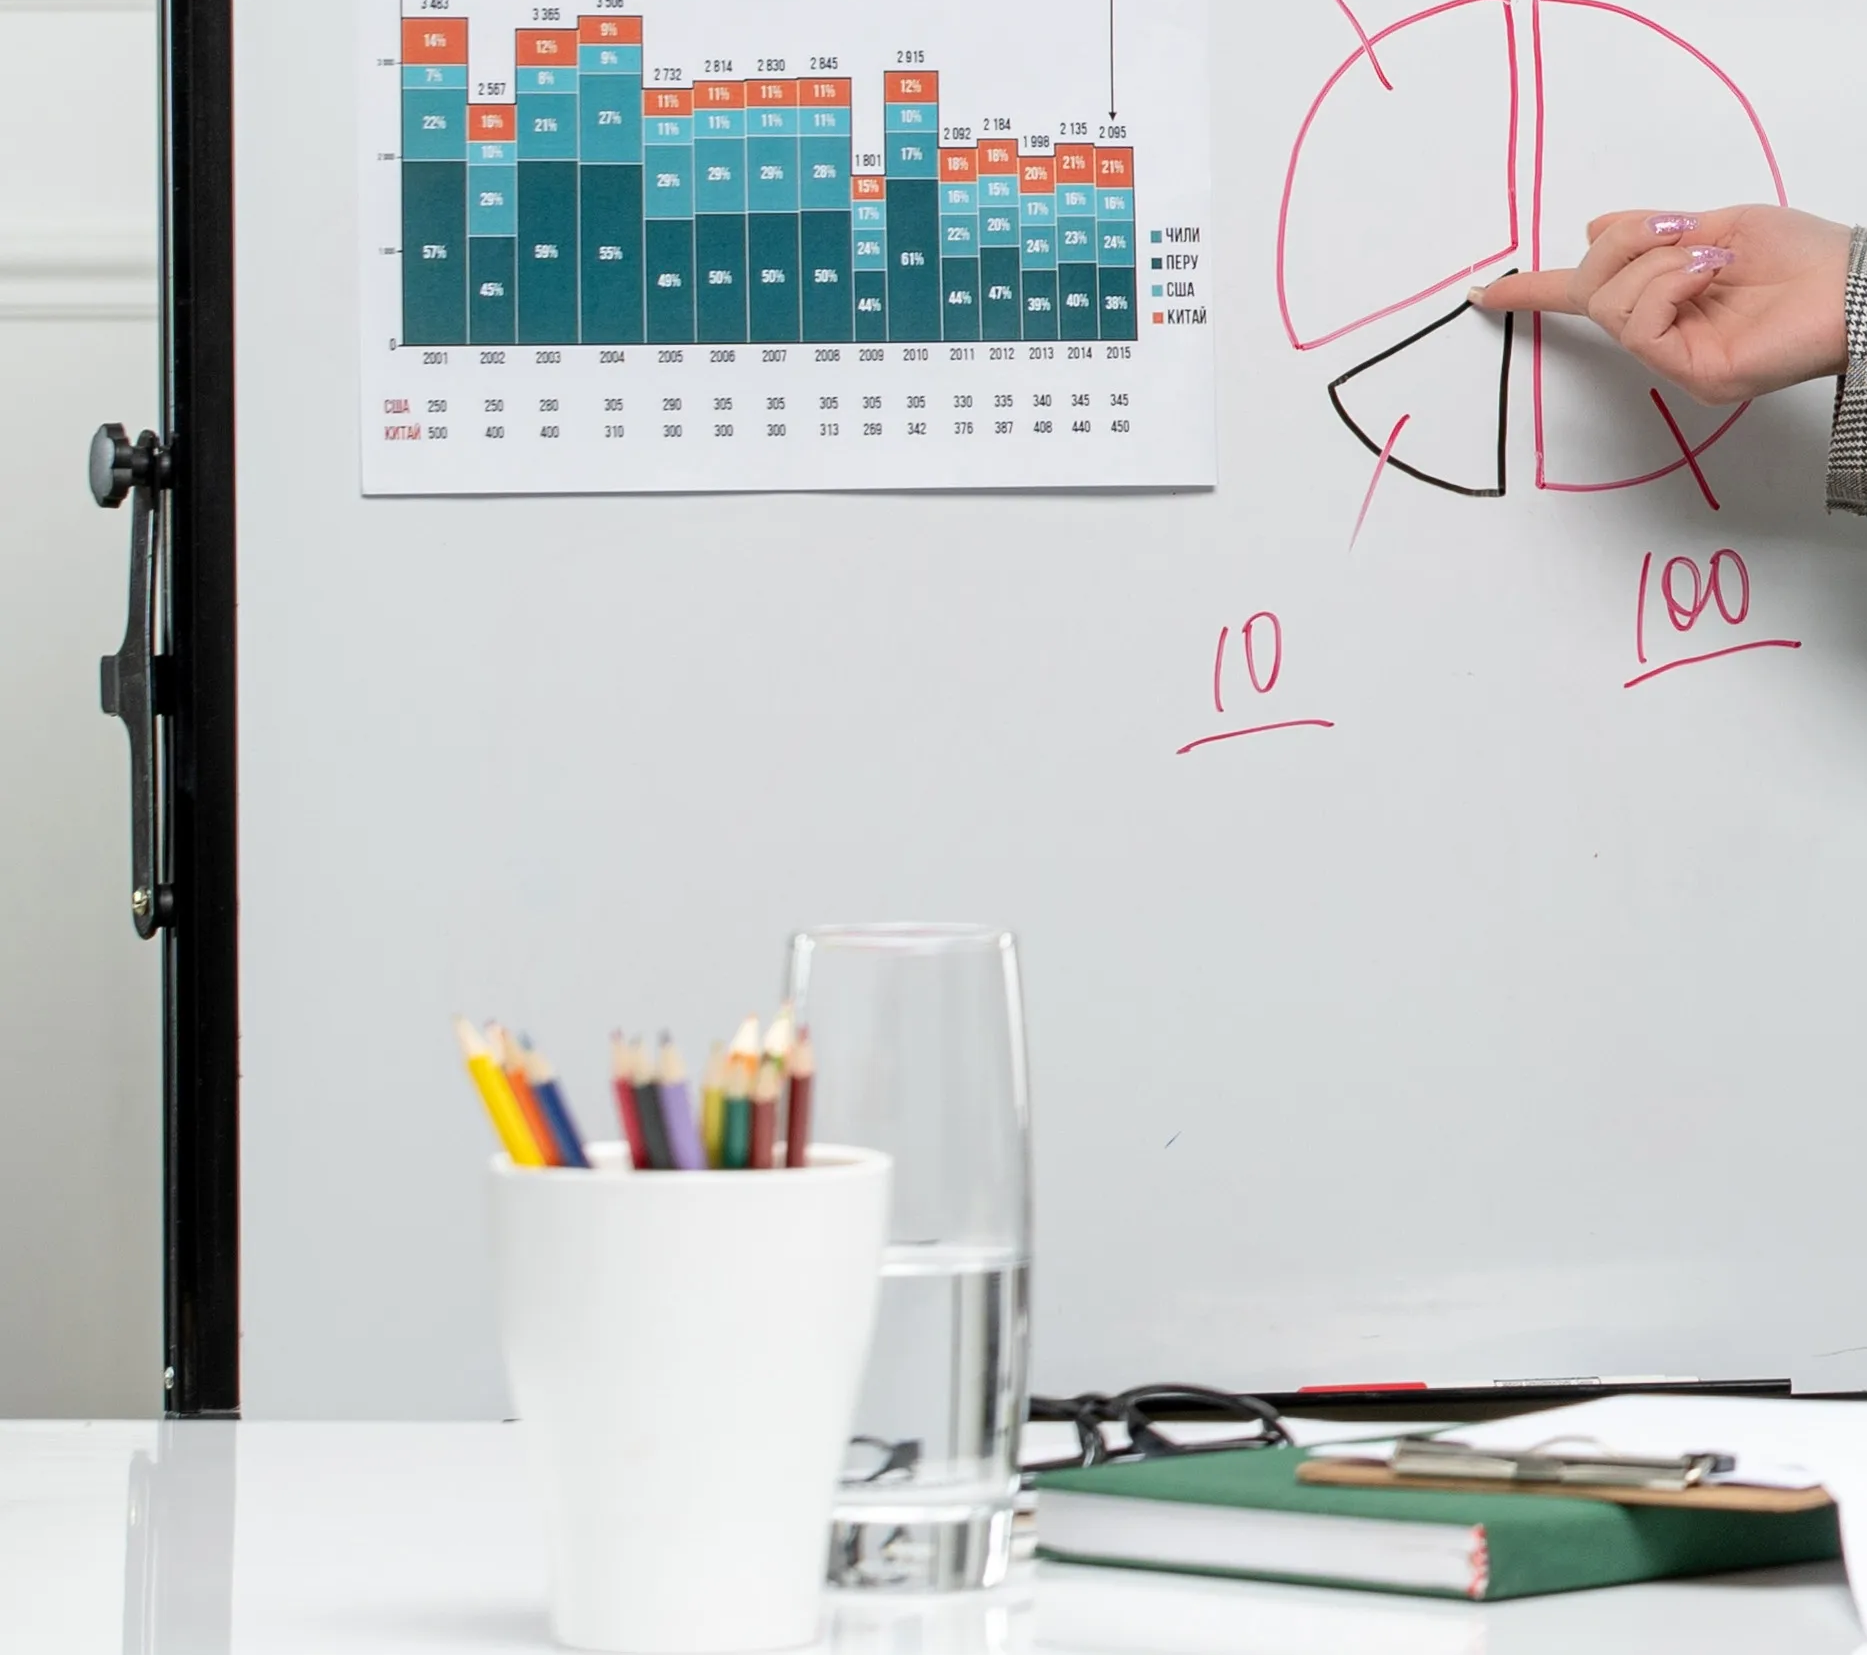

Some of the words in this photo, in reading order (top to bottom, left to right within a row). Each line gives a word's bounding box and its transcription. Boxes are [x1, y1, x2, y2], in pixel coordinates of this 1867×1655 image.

[424, 34, 446, 47] 14%
[536, 40, 558, 53] 12%
[426, 69, 442, 82] 7%
[761, 85, 783, 98] 11%
[813, 85, 835, 97] 11%
[900, 80, 921, 93] 12%
[708, 88, 730, 100] 11%
[658, 95, 679, 108] 11%
[422, 116, 446, 130] 22%
[598, 111, 622, 124] 27%
[708, 116, 730, 129] 11%
[761, 114, 783, 126] 11%
[814, 114, 835, 126] 11%
[535, 119, 557, 132] 21%
[658, 122, 679, 135] 11%
[901, 147, 922, 160] 17%
[987, 149, 1009, 162] 18%
[947, 157, 969, 170] 18%
[1063, 156, 1085, 169] 21%
[1102, 161, 1124, 174] 21%
[1025, 167, 1048, 180] 20%
[858, 180, 879, 192] 15%
[988, 182, 1009, 195] 15%
[858, 207, 879, 220] 17%
[1027, 202, 1049, 215] 17%
[987, 219, 1010, 231] 20%
[947, 228, 970, 241] 22%
[1065, 231, 1087, 244] 23%
[1166, 228, 1200, 243] ЧИЛИ
[857, 242, 880, 255] 24%
[1027, 240, 1049, 253] 24%
[1104, 236, 1126, 249] 24%
[422, 245, 447, 259] 57%
[535, 245, 559, 259] 59%
[599, 246, 623, 260] 55%
[900, 252, 924, 265] 61%
[1166, 255, 1198, 270] ПЕРУ
[658, 274, 681, 287] 49%
[708, 271, 732, 284] 50%
[761, 270, 785, 283] 50%
[814, 270, 838, 283] 50%
[480, 283, 504, 297] 45%
[988, 287, 1012, 299] 47%
[1167, 283, 1195, 297] США
[949, 291, 972, 304] 44%
[1066, 294, 1089, 307] 40%
[1105, 296, 1128, 309] 38%
[858, 298, 881, 312] 44%
[1027, 298, 1051, 311] 39%
[1167, 307, 1207, 324] КИТАЙ
[423, 352, 448, 364] 2001
[480, 352, 506, 364] 2002
[536, 351, 561, 364] 2003
[600, 351, 625, 363] 2004
[658, 350, 683, 363] 2005
[710, 350, 735, 362] 2006
[762, 350, 787, 362] 2007
[815, 349, 840, 362] 2008
[859, 349, 884, 361] 2009
[903, 349, 928, 361] 2010
[950, 348, 975, 360] 2011
[990, 348, 1014, 360] 2012
[1029, 348, 1054, 360] 2013
[1067, 347, 1092, 359] 2014
[1106, 347, 1131, 359] 2015
[384, 399, 410, 413] США
[428, 400, 447, 412] 250
[485, 400, 504, 412] 250
[604, 399, 623, 411] 305
[662, 398, 681, 411] 290
[713, 398, 732, 410] 305
[766, 398, 785, 410] 305
[820, 397, 839, 409] 305
[862, 397, 881, 409] 305
[907, 396, 926, 409] 305
[954, 396, 973, 408] 330
[994, 395, 1013, 408] 335
[1033, 395, 1052, 407] 340
[1071, 394, 1090, 406] 345
[1110, 394, 1129, 406] 345
[384, 424, 421, 440] КИТАЙ
[428, 427, 447, 439] 500
[485, 426, 504, 438] 400
[540, 426, 559, 438] 400
[605, 425, 624, 438] 310
[664, 425, 682, 437] 300
[715, 425, 733, 437] 300
[767, 424, 786, 437] 300
[820, 424, 839, 436] 313
[908, 422, 927, 435] 342
[954, 422, 974, 434] 376
[995, 422, 1013, 434] 387
[1034, 421, 1052, 433] 408
[1072, 421, 1091, 433] 440
[1111, 420, 1130, 433] 450
[1638, 548, 1750, 665] 100
[1214, 611, 1282, 712] 10
